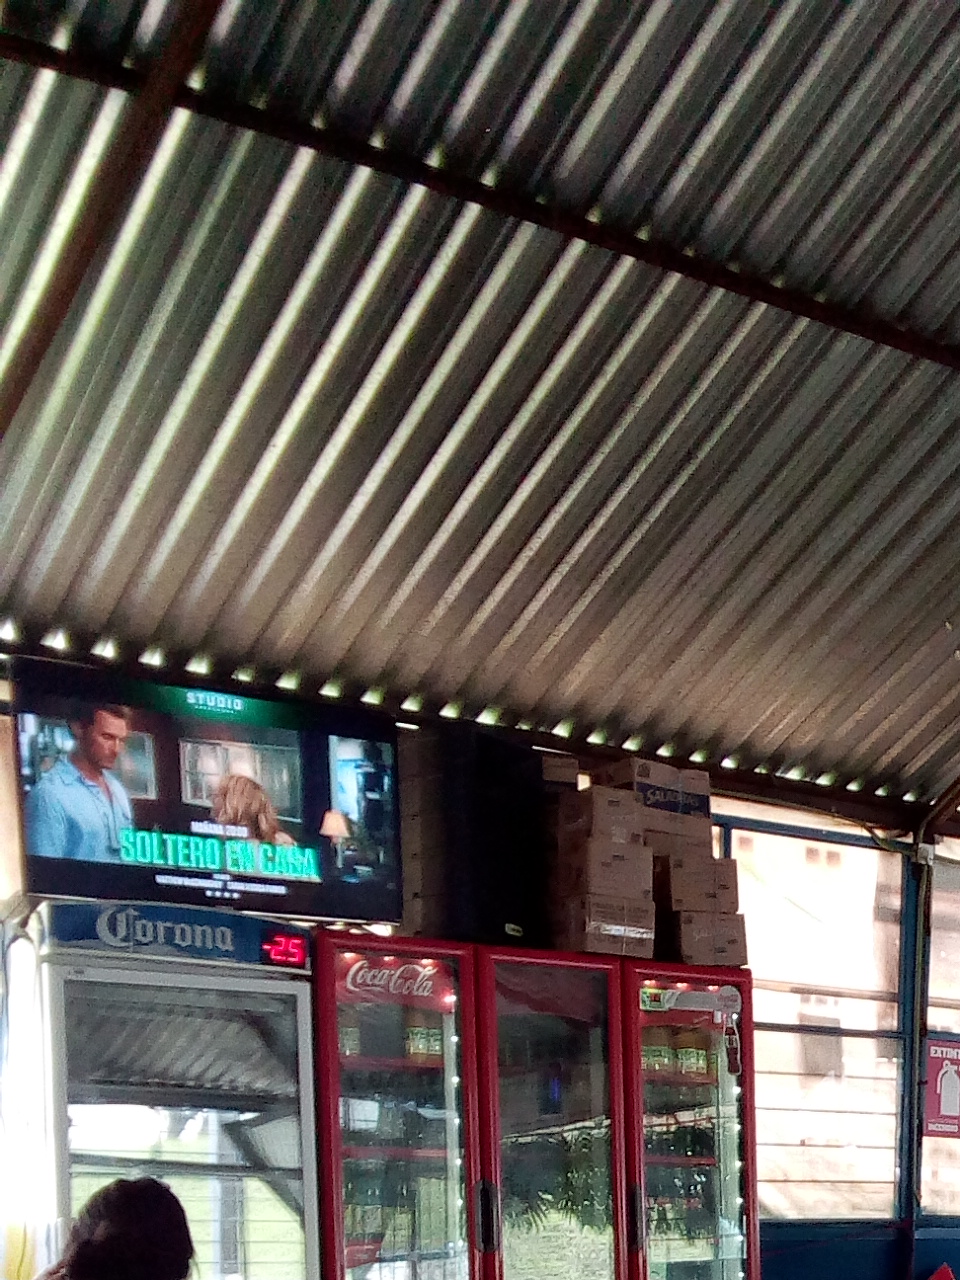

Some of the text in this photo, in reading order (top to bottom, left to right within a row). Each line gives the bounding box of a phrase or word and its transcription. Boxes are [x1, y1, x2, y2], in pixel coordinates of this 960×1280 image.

[186, 691, 243, 711] STUDIO
[120, 828, 220, 870] SOLTERO
[224, 838, 256, 873] EN
[95, 906, 235, 951] Corona
[346, 960, 440, 998] Coca-Cola
